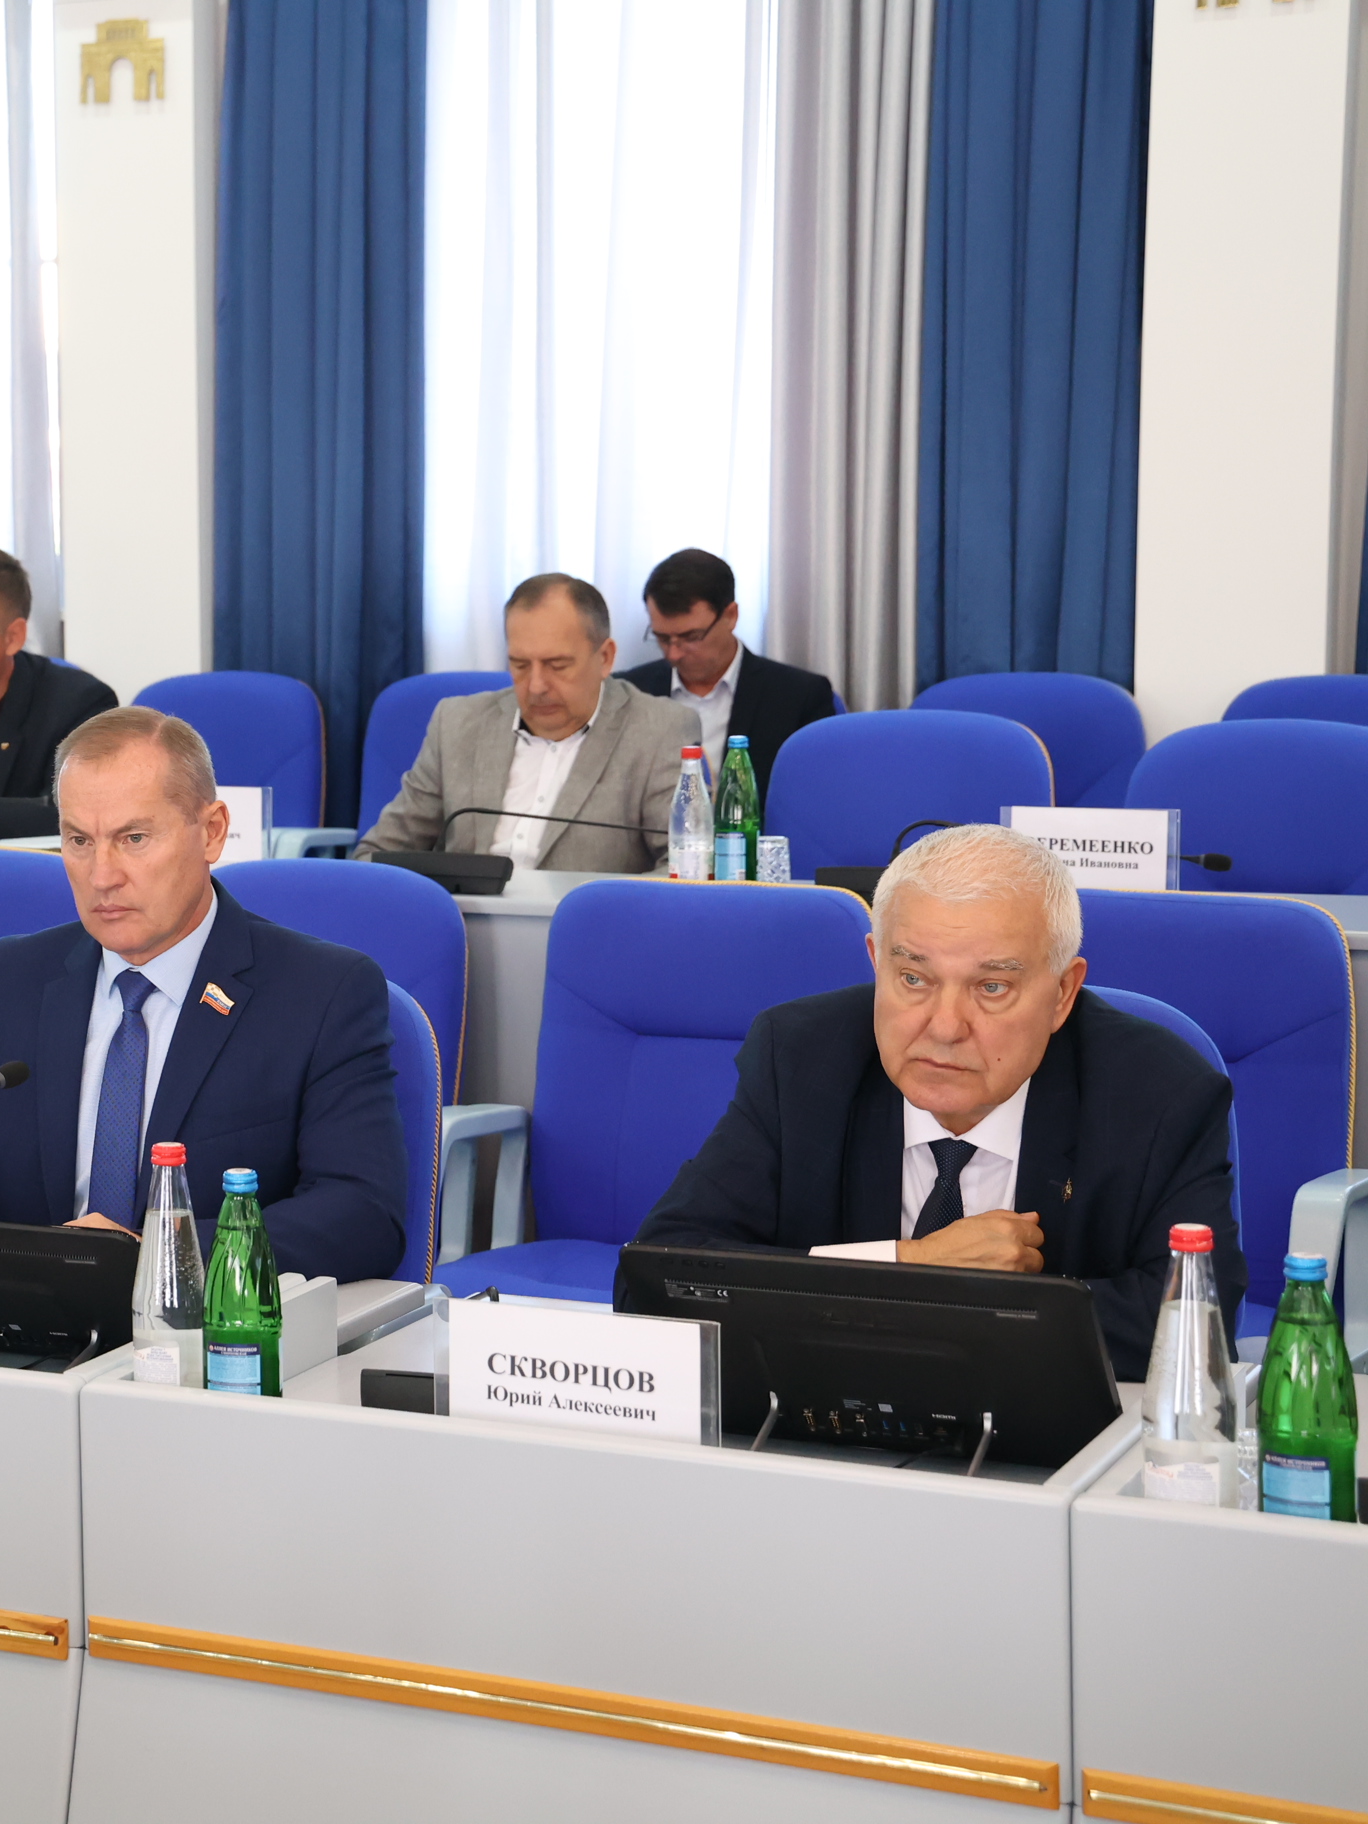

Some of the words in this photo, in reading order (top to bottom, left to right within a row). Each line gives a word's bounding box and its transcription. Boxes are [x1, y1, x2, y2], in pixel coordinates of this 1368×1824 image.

[1080, 857, 1139, 870] Ивановна
[487, 1352, 656, 1394] СКВОРЦОВ
[487, 1384, 543, 1407] Юрий
[548, 1393, 656, 1421] Алексеевич
